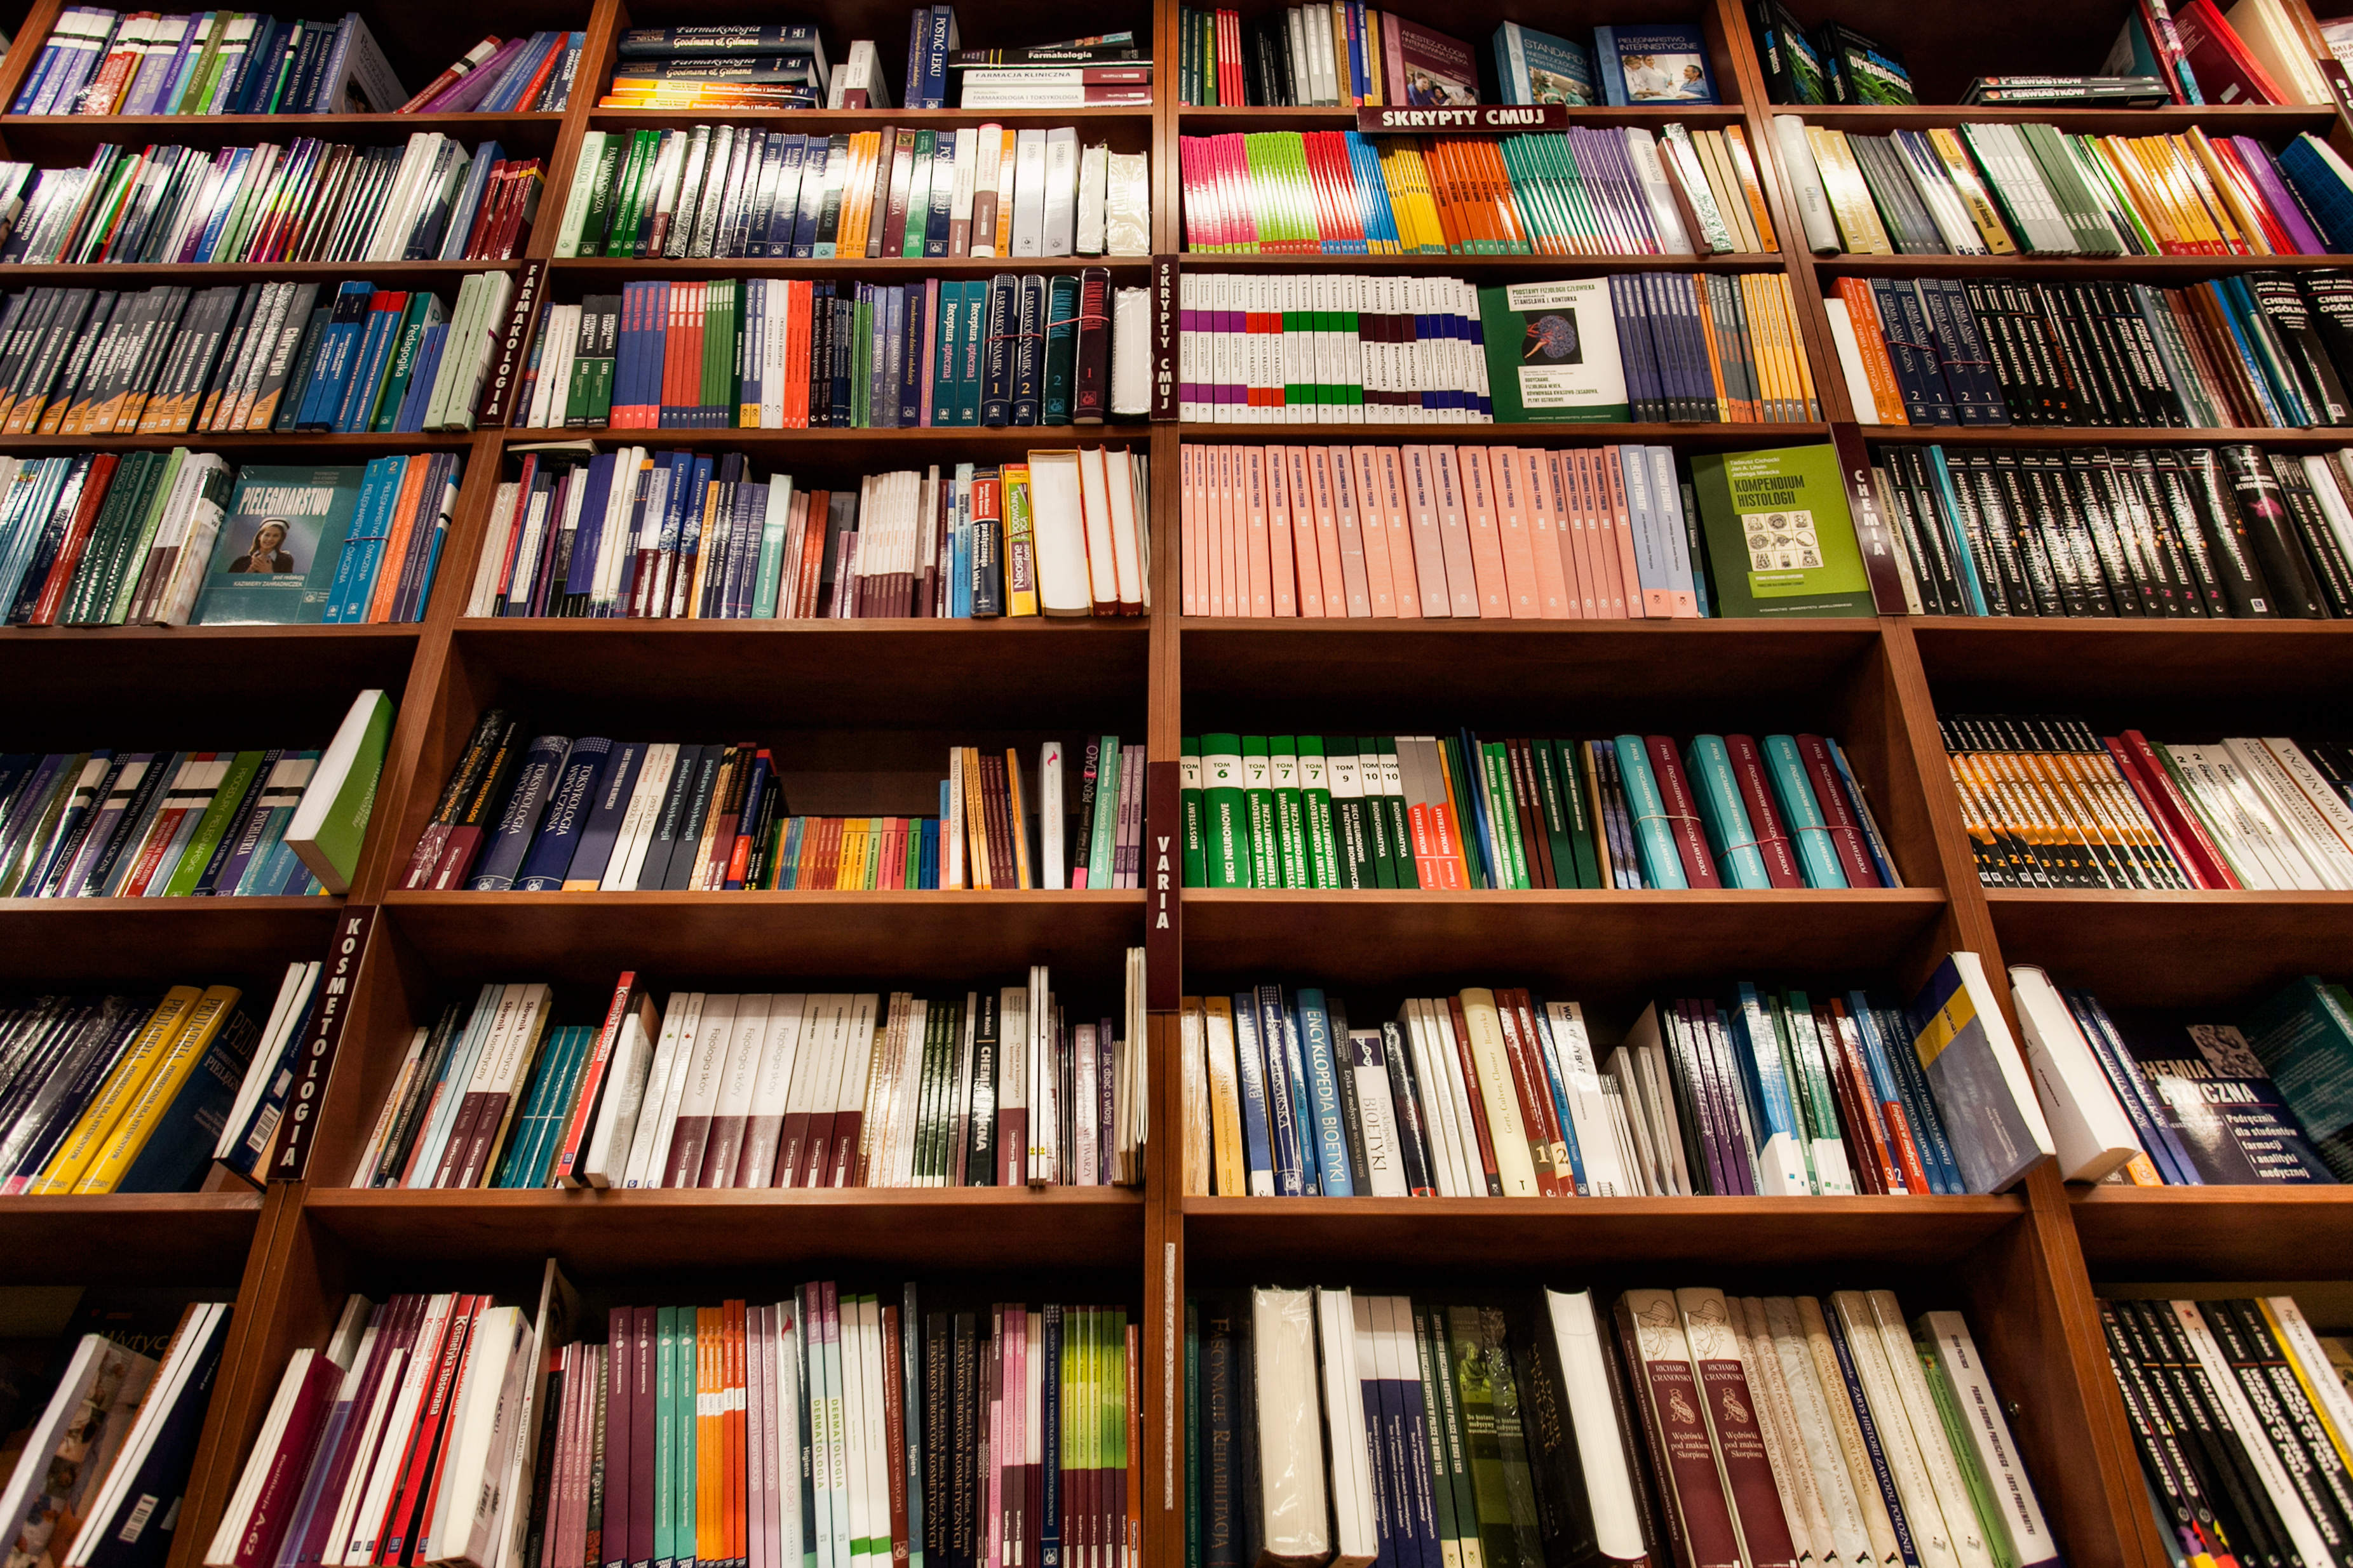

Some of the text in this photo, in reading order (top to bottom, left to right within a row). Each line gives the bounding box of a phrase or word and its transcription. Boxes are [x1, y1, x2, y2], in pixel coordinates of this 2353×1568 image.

[673, 37, 759, 48] Goodmana Gilmana
[677, 25, 761, 34] Farmakologia
[930, 17, 946, 77] POSTAĆ LEKU
[666, 67, 752, 78] Goodmana Gilmana
[1028, 51, 1092, 59] Farmakologia
[1382, 109, 1546, 126] SKRYPTY CMUJ
[2263, 298, 2303, 306] CHEMIA
[487, 265, 537, 415] FARMAKOLOGIA
[583, 314, 591, 336] TERAPIA
[586, 314, 597, 349] INTENSYWNA
[606, 314, 616, 349] INTENSYWNA
[942, 302, 958, 379] Receptura apteczna
[966, 302, 981, 379] Receptura apteczna
[1158, 264, 1172, 410] SKRYPTY CMUJ
[269, 326, 300, 377] Chirurgia
[395, 324, 420, 378] Pedagogika
[992, 384, 999, 394] 1
[1021, 382, 1030, 394] 2
[1054, 375, 1062, 385] 2
[1087, 368, 1092, 378] 1
[1911, 391, 1920, 401] 2
[1936, 393, 1943, 402] 1
[1961, 392, 1970, 401] 2
[1986, 391, 1992, 401] 1
[159, 419, 170, 427] 23
[176, 418, 187, 426] 23
[389, 461, 398, 472] 2
[1734, 475, 1805, 492] KOMPENDIUM
[238, 487, 334, 516] PIELĘGNIARSTWO
[1737, 491, 1796, 507] HISTOLOGII
[1854, 469, 1885, 556] CHEMIA
[980, 524, 988, 567] praktycznego
[1013, 545, 1024, 589] Neosine
[1188, 770, 1194, 779] 1
[1217, 770, 1228, 778] 6
[1253, 770, 1262, 779] 7
[2009, 756, 2028, 782] CHEMIA
[2282, 748, 2348, 823] ORGANICZNA
[508, 762, 549, 836] TOKSYKOLOGIA
[556, 763, 594, 836] TOKSYKOLOGIA
[236, 810, 270, 855] PSYCHIATRIA
[1188, 801, 1198, 850] BIOSYSTEMY
[1220, 803, 1236, 883] SIECI NEURONOWE
[1251, 793, 1263, 854] KOMPUTEROWE
[1372, 801, 1386, 858] BIOINFORMATYKA
[1392, 801, 1408, 859] BIOINFORMATYKA
[1412, 807, 1429, 855] BIOMATERIAŁY
[1433, 807, 1450, 855] BIOMATERIAŁY
[1692, 842, 1708, 876] PODSTAWY
[1156, 836, 1170, 928] VARIA
[128, 998, 185, 1061] PEDIATRIA
[166, 998, 222, 1060] PEDIATRIA
[281, 918, 362, 1167] KOSMETOLOGIA
[597, 986, 628, 1062] Kosmetyka stosowana
[695, 1028, 722, 1097] Fizjologia skóry
[1306, 1010, 1345, 1183] ENCYKLOPEDIA BIOETYKI
[1363, 1098, 1387, 1171] BIOETYKI
[1892, 1104, 1920, 1177] Empatia medycynie
[2226, 1113, 2277, 1125] Podręcznik
[2234, 1126, 2297, 1137] dla studentów
[2242, 1140, 2282, 1151] farmacji
[2256, 1153, 2298, 1166] analityki
[1885, 1167, 1893, 1181] 3
[1894, 1169, 1903, 1181] 2
[2258, 1166, 2309, 1179] medycznej
[430, 1315, 468, 1415] Kosmetyka stosowana
[929, 1339, 938, 1392] LEKSYKON
[2152, 1370, 2188, 1431] POLIMERY
[2194, 1370, 2233, 1431] POLIMERY
[813, 1399, 825, 1491] DERMATOLOGIA
[831, 1398, 842, 1490] DERMATOLOGIA
[909, 1445, 917, 1477] Higiena
[1852, 1386, 1868, 1418] ZARYS
[1863, 1417, 1880, 1454] HISTORII
[1876, 1458, 1896, 1503] ZAWODU
[927, 1450, 936, 1550] KOSMETYCZNYCH
